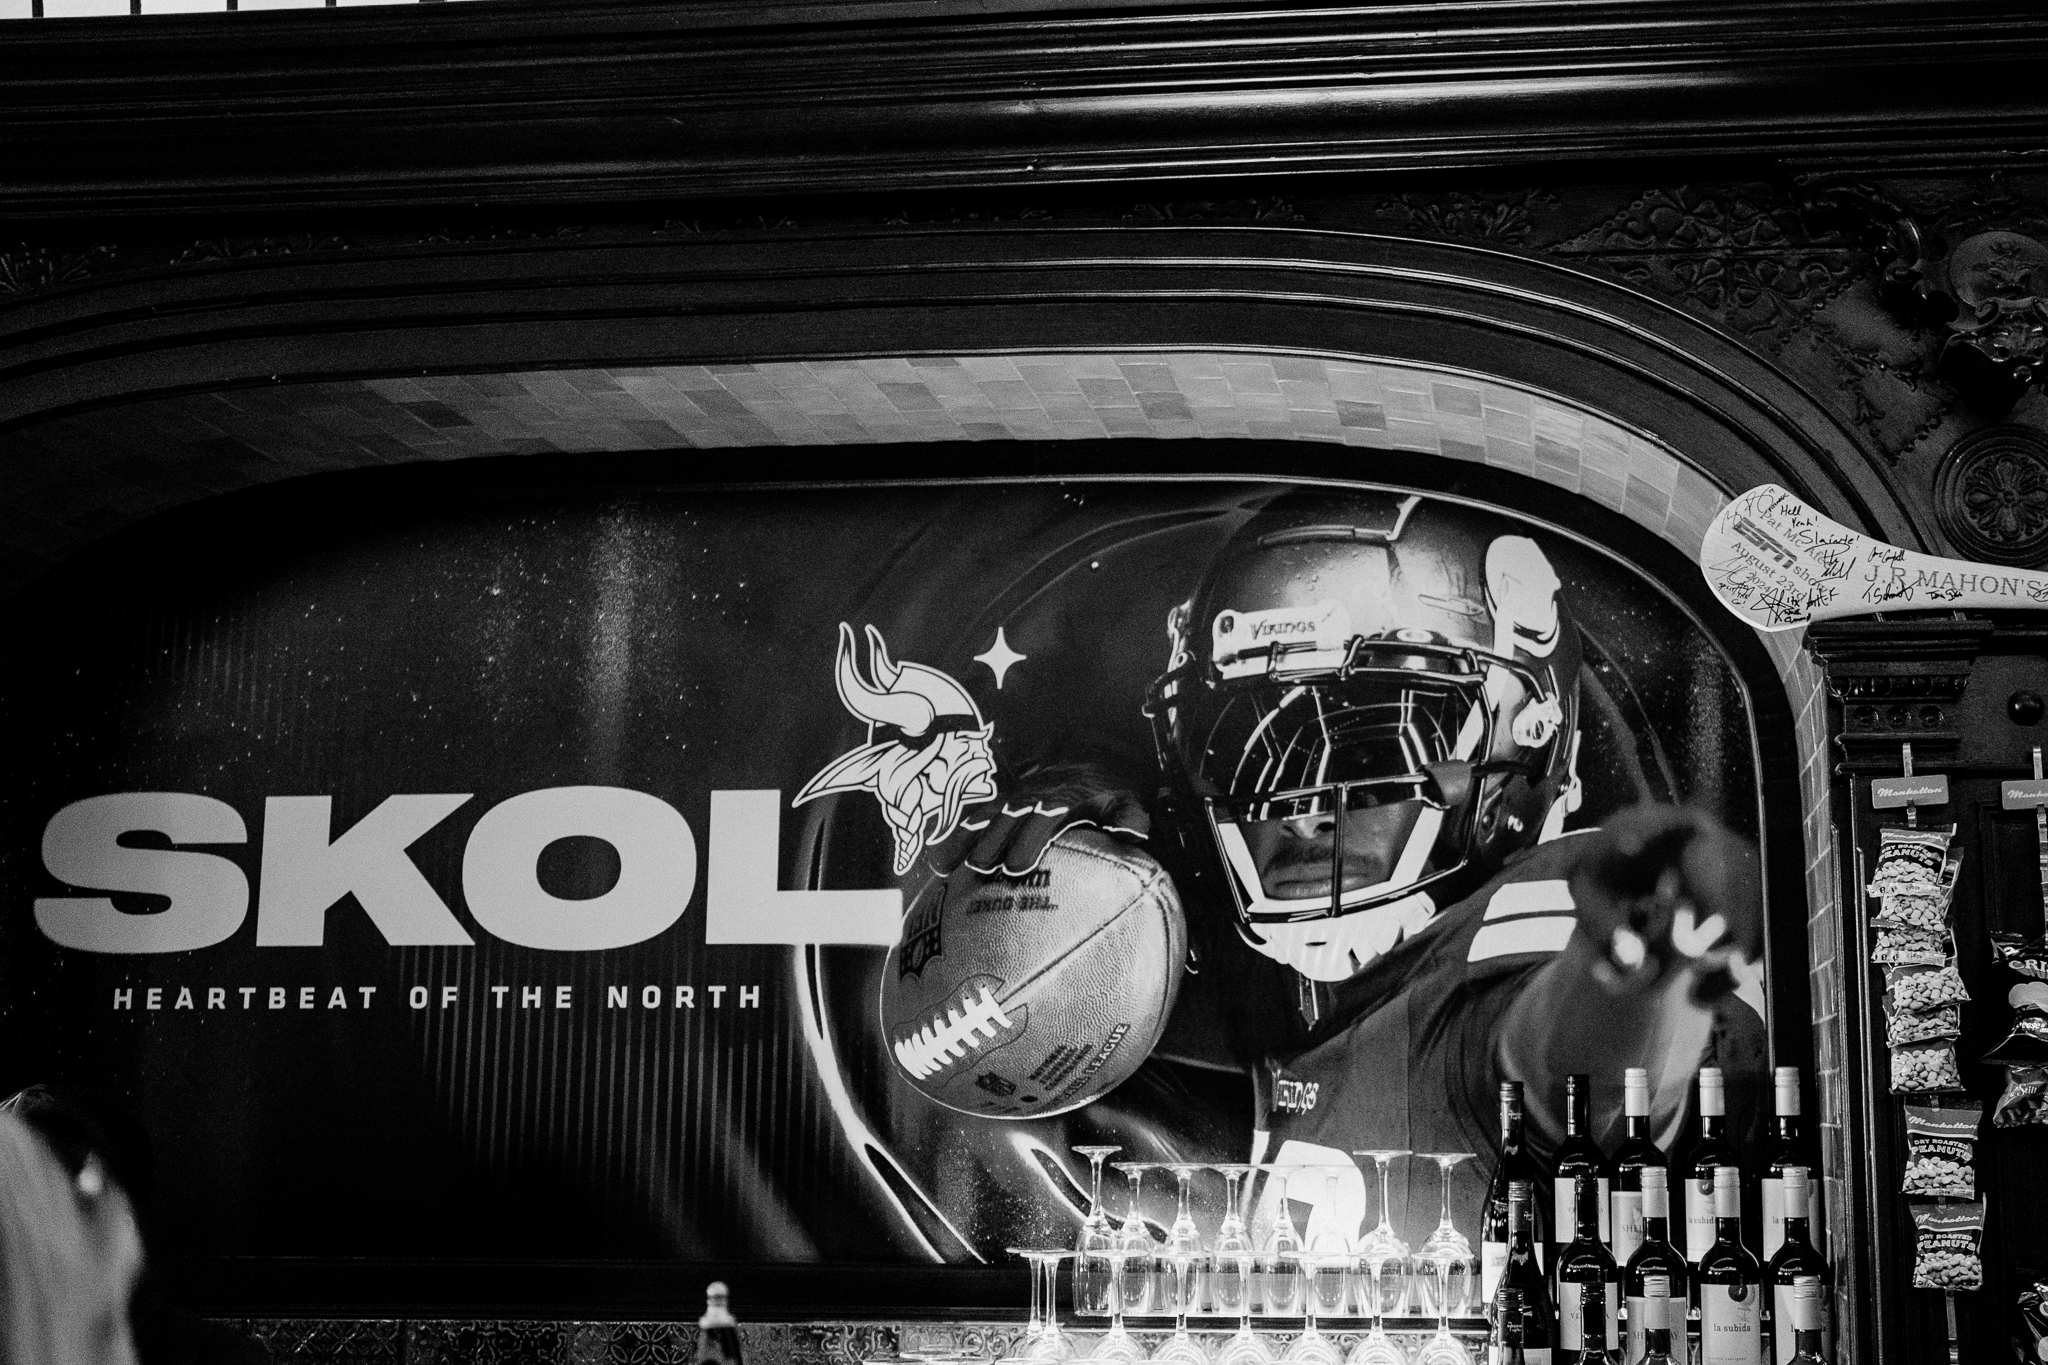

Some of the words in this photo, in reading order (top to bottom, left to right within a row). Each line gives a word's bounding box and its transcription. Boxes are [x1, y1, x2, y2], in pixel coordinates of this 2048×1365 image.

[1780, 504, 1801, 516] Hell
[1761, 509, 1782, 531] Pat
[1732, 516, 1798, 570] ESPN
[1731, 542, 1777, 579] August
[1776, 575, 1808, 601] 23rd
[1746, 572, 1771, 593] 2024
[1864, 565, 1907, 585] J.R
[1916, 570, 2042, 597] MAHON'S
[1877, 787, 1944, 797] Manhattan
[34, 786, 904, 954] SKOL
[2008, 959, 2048, 973] CRI
[114, 986, 377, 1010] HEARTBEAT
[410, 986, 458, 1009] OF
[491, 985, 572, 1009] THE
[608, 985, 760, 1009] NORTH
[1085, 1023, 1129, 1074] LEAGUE
[1908, 1116, 1977, 1129] Manhattan
[1932, 1139, 1968, 1150] ROASTED
[1911, 1145, 1973, 1163] PEANUTS
[1694, 1216, 1716, 1224] subid
[1917, 1240, 1977, 1251] PEANUTS
[1713, 1323, 1721, 1332] la
[1723, 1323, 1751, 1332] subida
